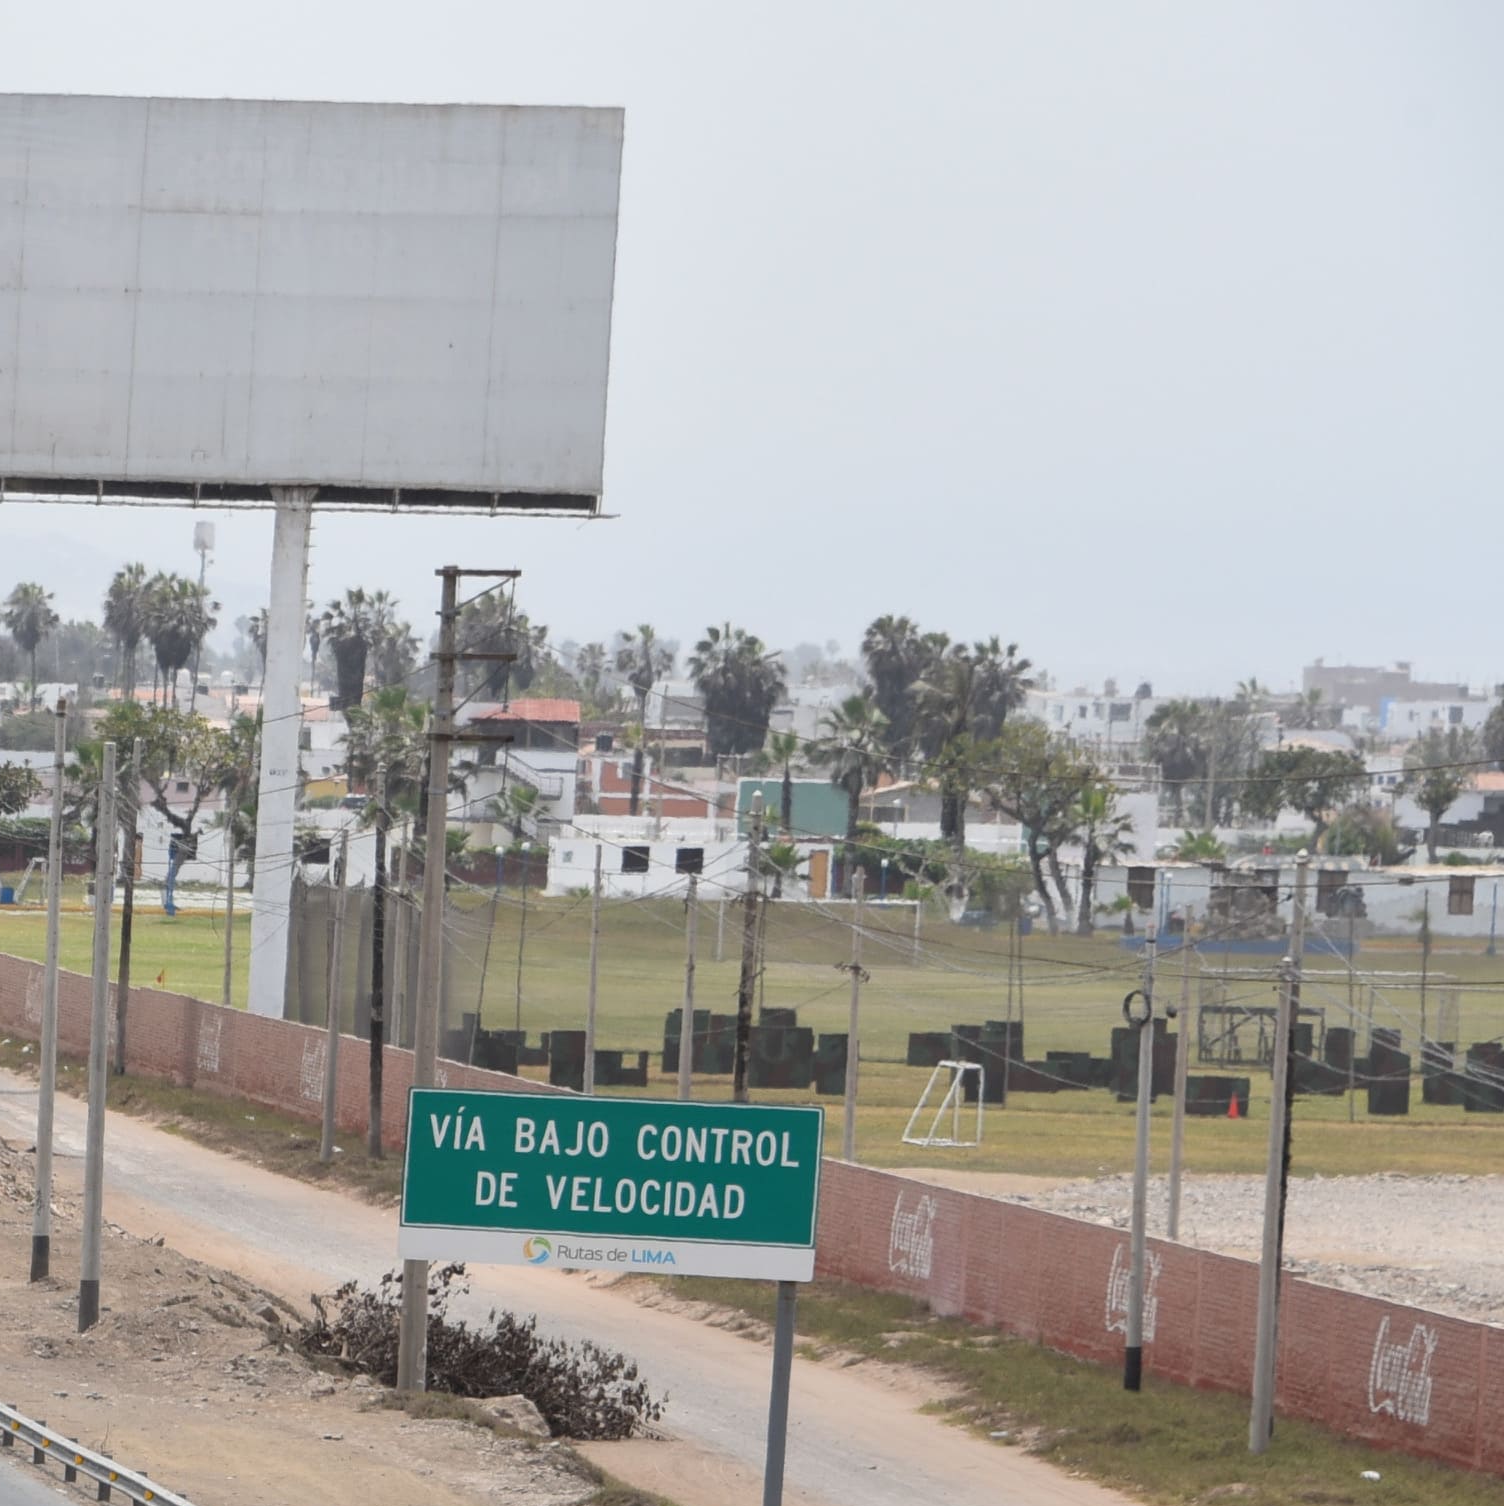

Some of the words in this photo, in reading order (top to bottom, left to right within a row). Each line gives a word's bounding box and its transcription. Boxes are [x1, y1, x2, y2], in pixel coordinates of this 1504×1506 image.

[430, 1106, 486, 1151] VÍA
[515, 1117, 609, 1158] BAJO
[637, 1124, 799, 1168] CONTROL
[475, 1171, 518, 1207] DE
[546, 1175, 746, 1219] VELOCIDAD
[557, 1245, 603, 1262] Rutas
[606, 1246, 628, 1262] de
[632, 1249, 676, 1265] LIMA
